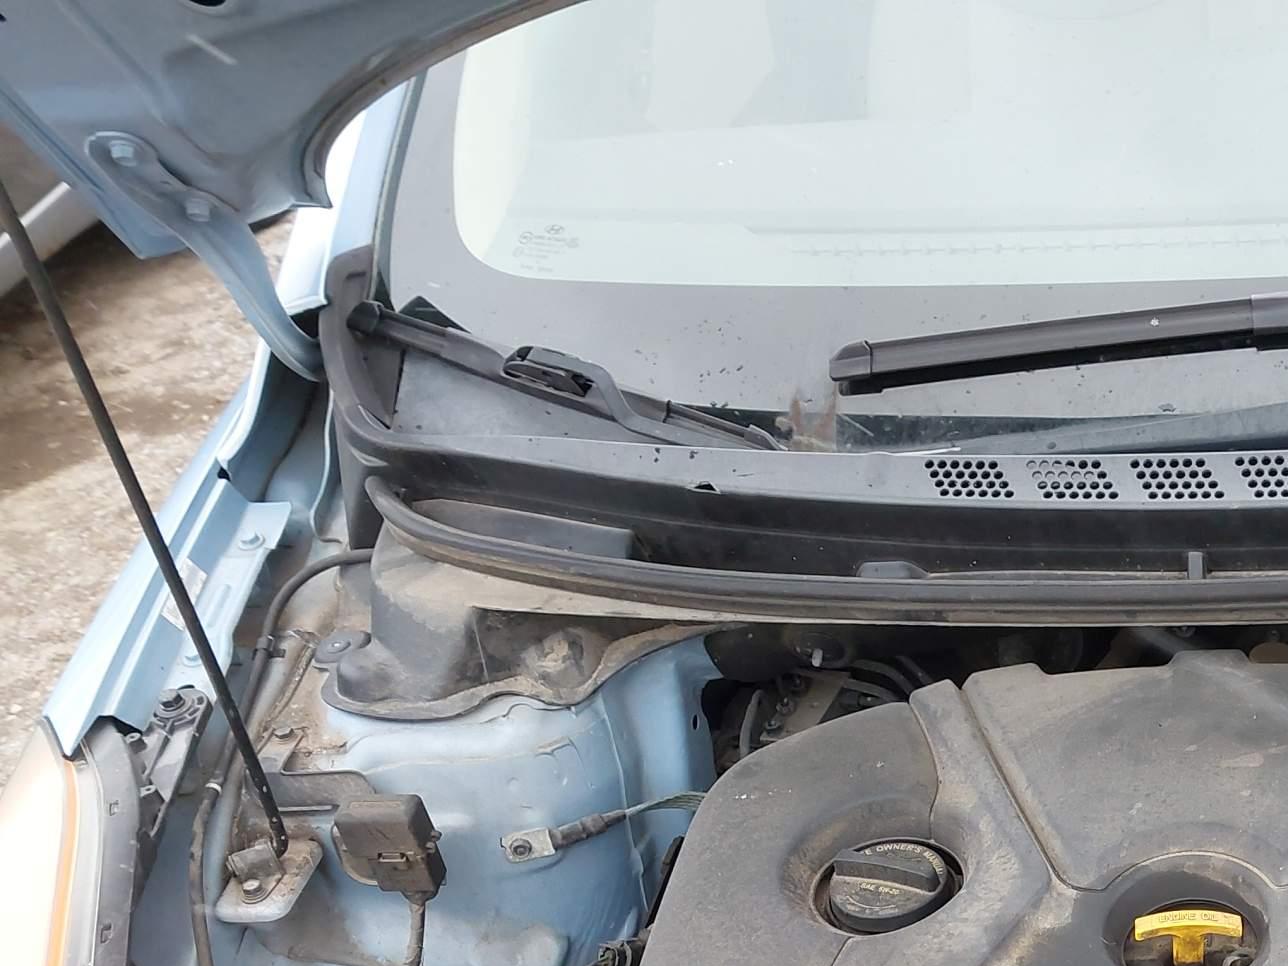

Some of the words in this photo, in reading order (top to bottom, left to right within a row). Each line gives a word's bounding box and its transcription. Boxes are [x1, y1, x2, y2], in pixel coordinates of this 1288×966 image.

[876, 843, 922, 853] OWNER'S
[1158, 912, 1197, 922] ENGINE
[1201, 912, 1218, 922] OIL
